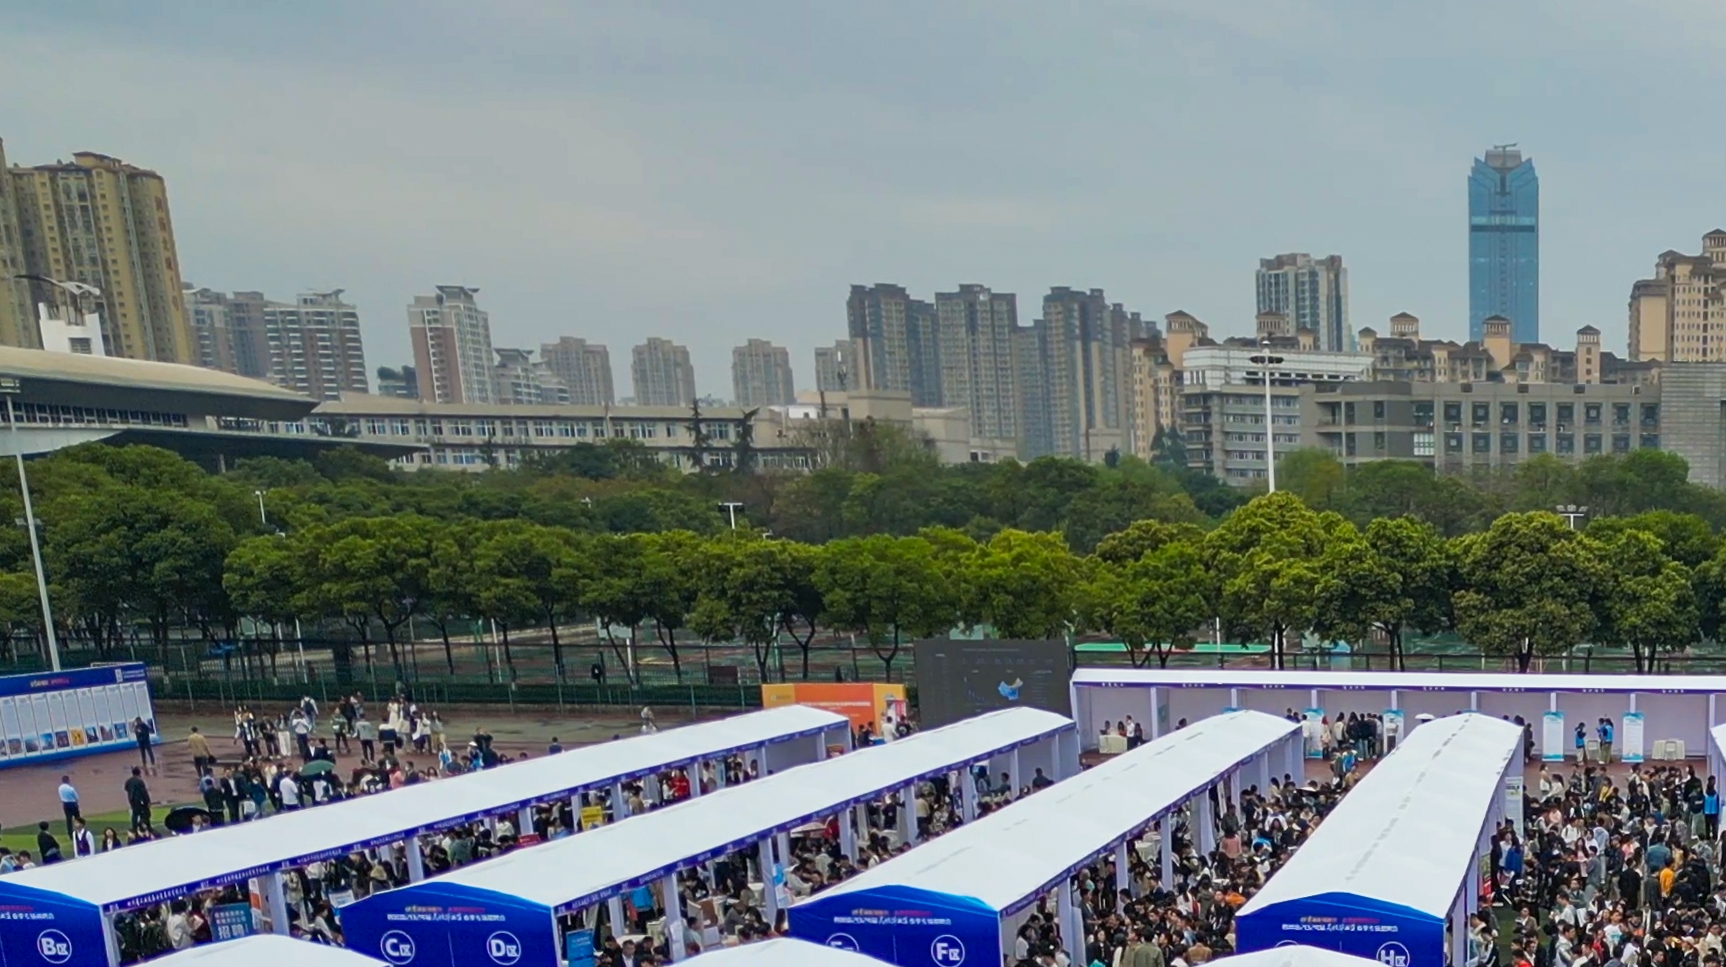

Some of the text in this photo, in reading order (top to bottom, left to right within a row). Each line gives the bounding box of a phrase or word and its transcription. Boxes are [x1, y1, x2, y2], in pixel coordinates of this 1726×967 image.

[384, 938, 413, 958] C区
[490, 939, 520, 958] D区
[935, 942, 961, 961] F区
